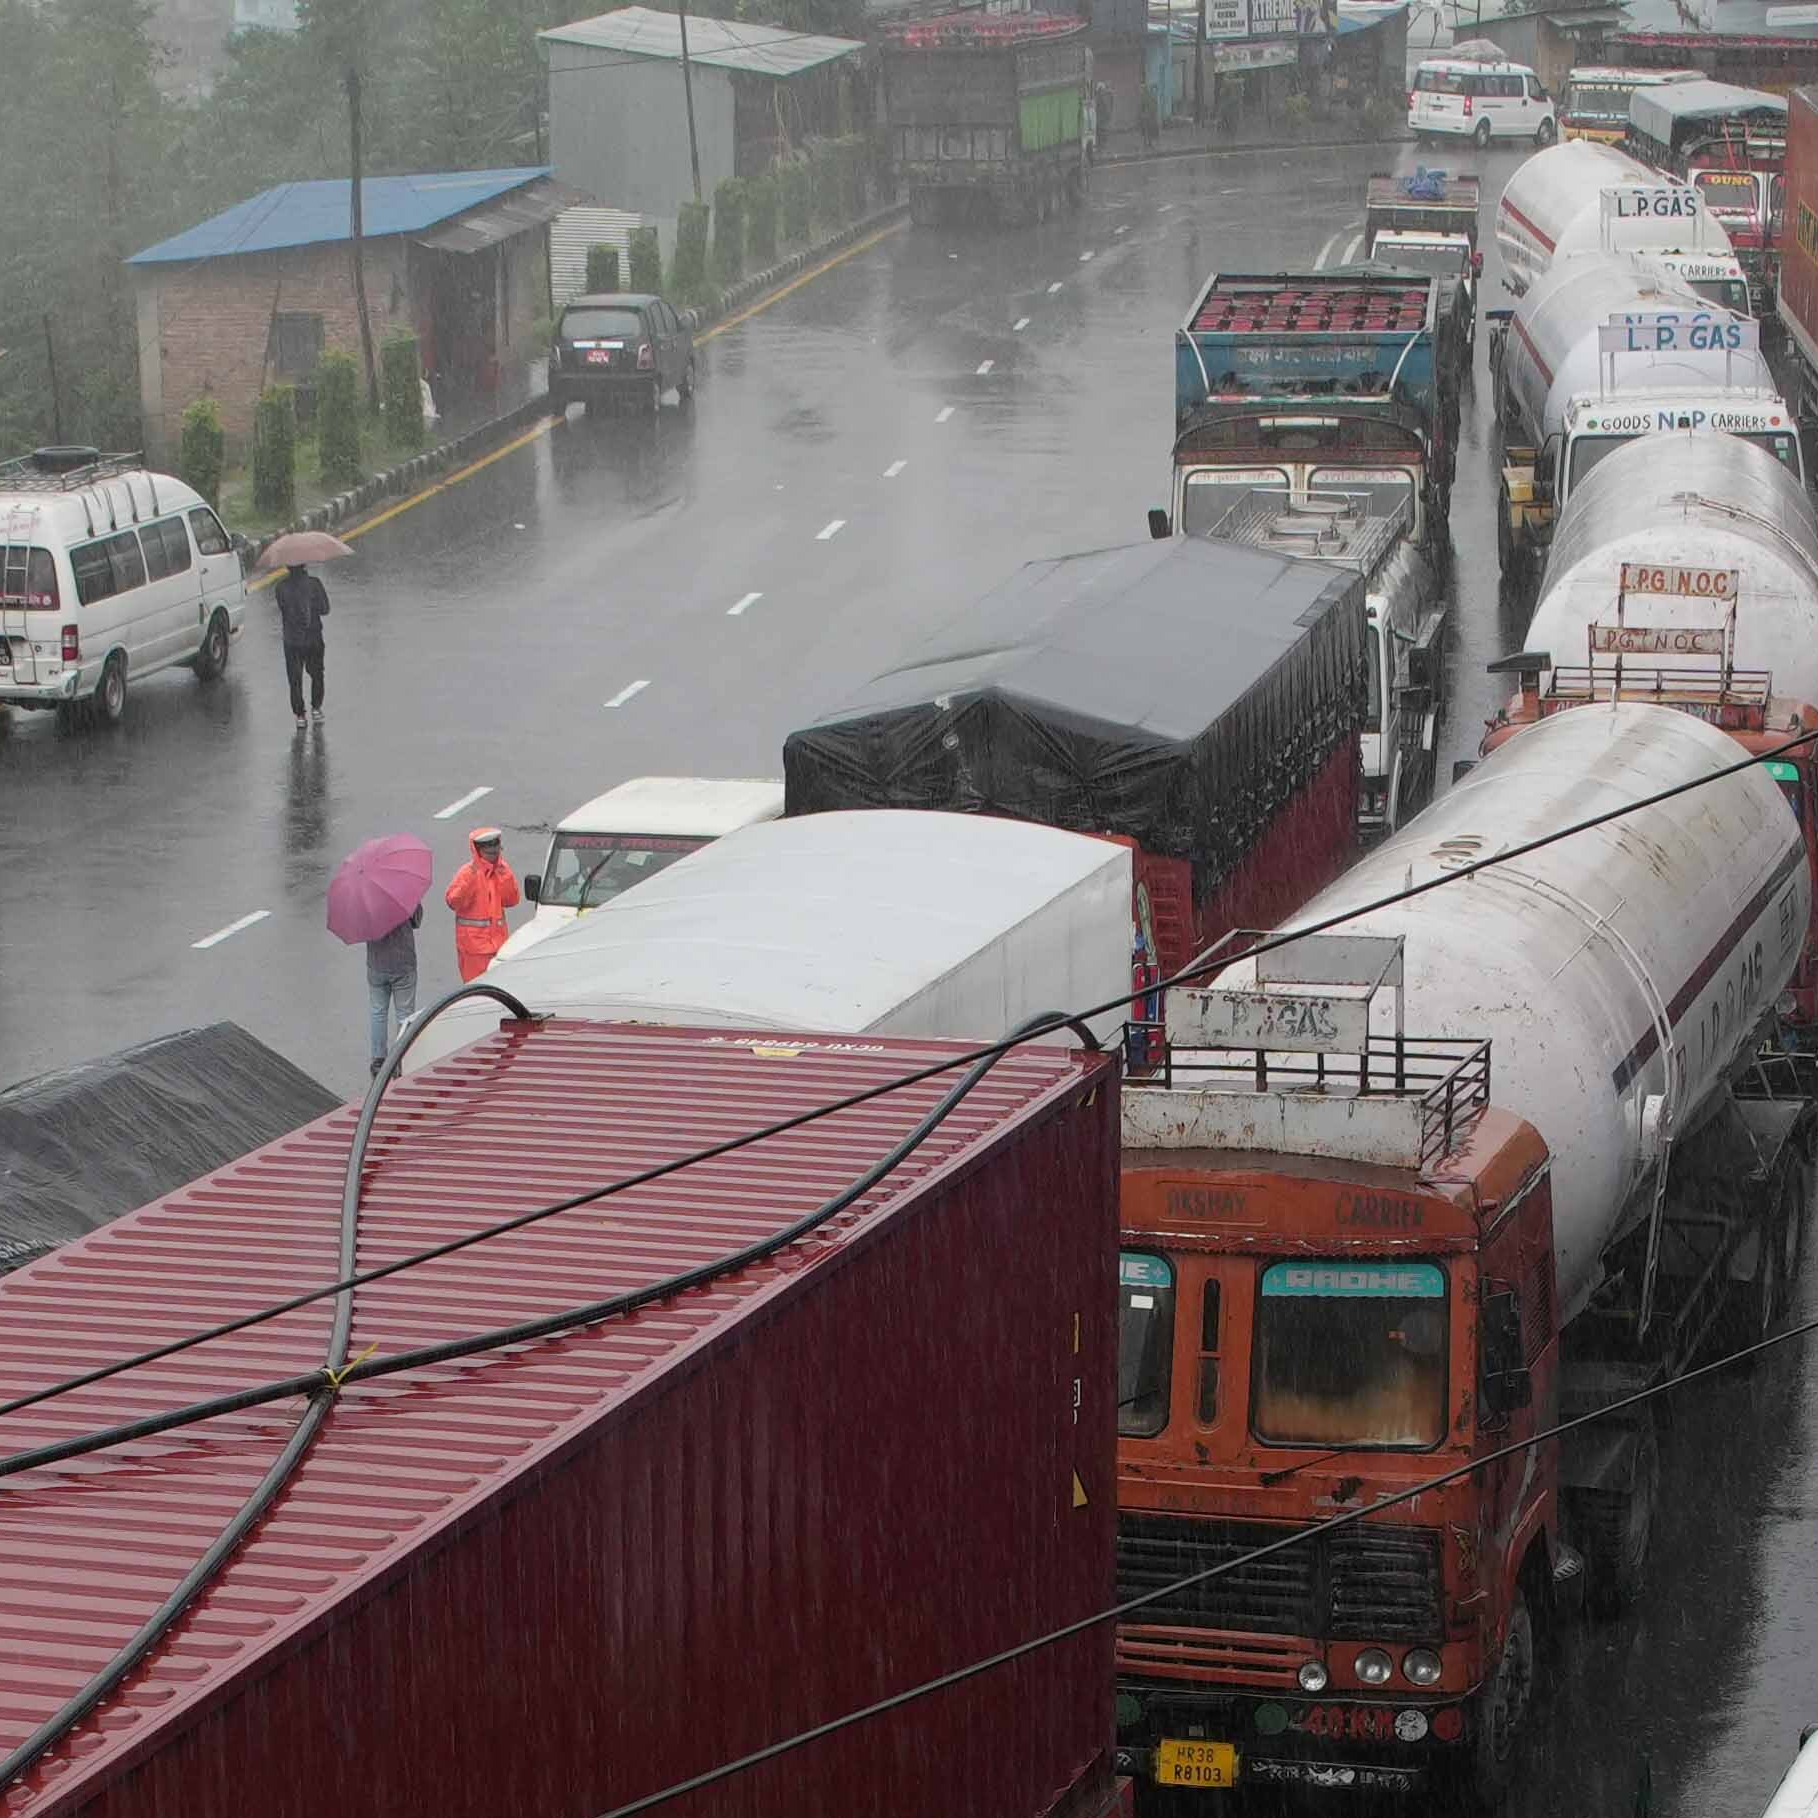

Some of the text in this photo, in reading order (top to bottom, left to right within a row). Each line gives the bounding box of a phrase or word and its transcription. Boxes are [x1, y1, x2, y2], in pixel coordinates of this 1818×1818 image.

[1689, 325, 1741, 350] GAS
[1601, 413, 1651, 430] GOODS
[1710, 412, 1766, 428] CARRIERS
[1175, 1747, 1214, 1763] HR38
[1174, 1766, 1221, 1781] R8103
